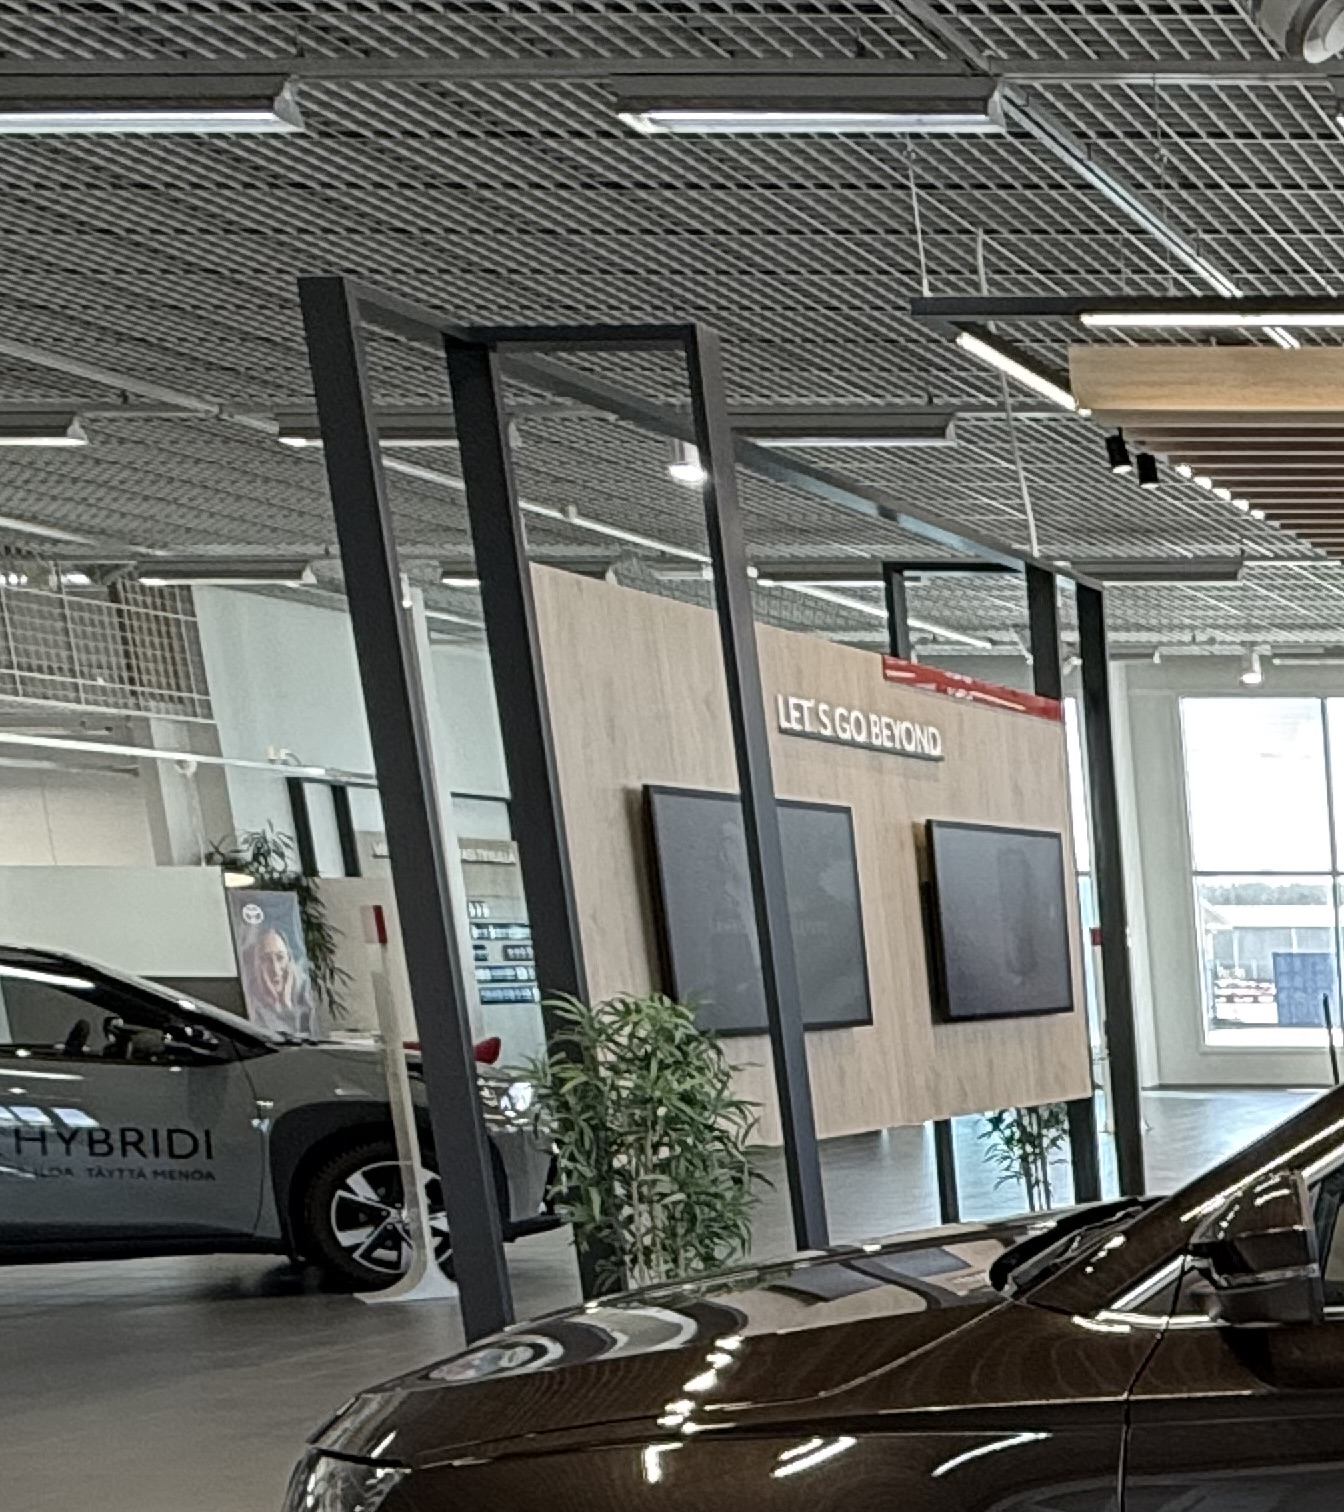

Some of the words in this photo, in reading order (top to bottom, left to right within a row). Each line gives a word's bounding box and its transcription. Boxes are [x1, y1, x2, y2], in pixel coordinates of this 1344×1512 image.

[777, 693, 832, 736] LET'S
[835, 707, 867, 743] GO
[869, 713, 942, 755] BEYOND
[14, 1127, 214, 1160] HYBRIDI
[152, 1168, 216, 1181] MENOA
